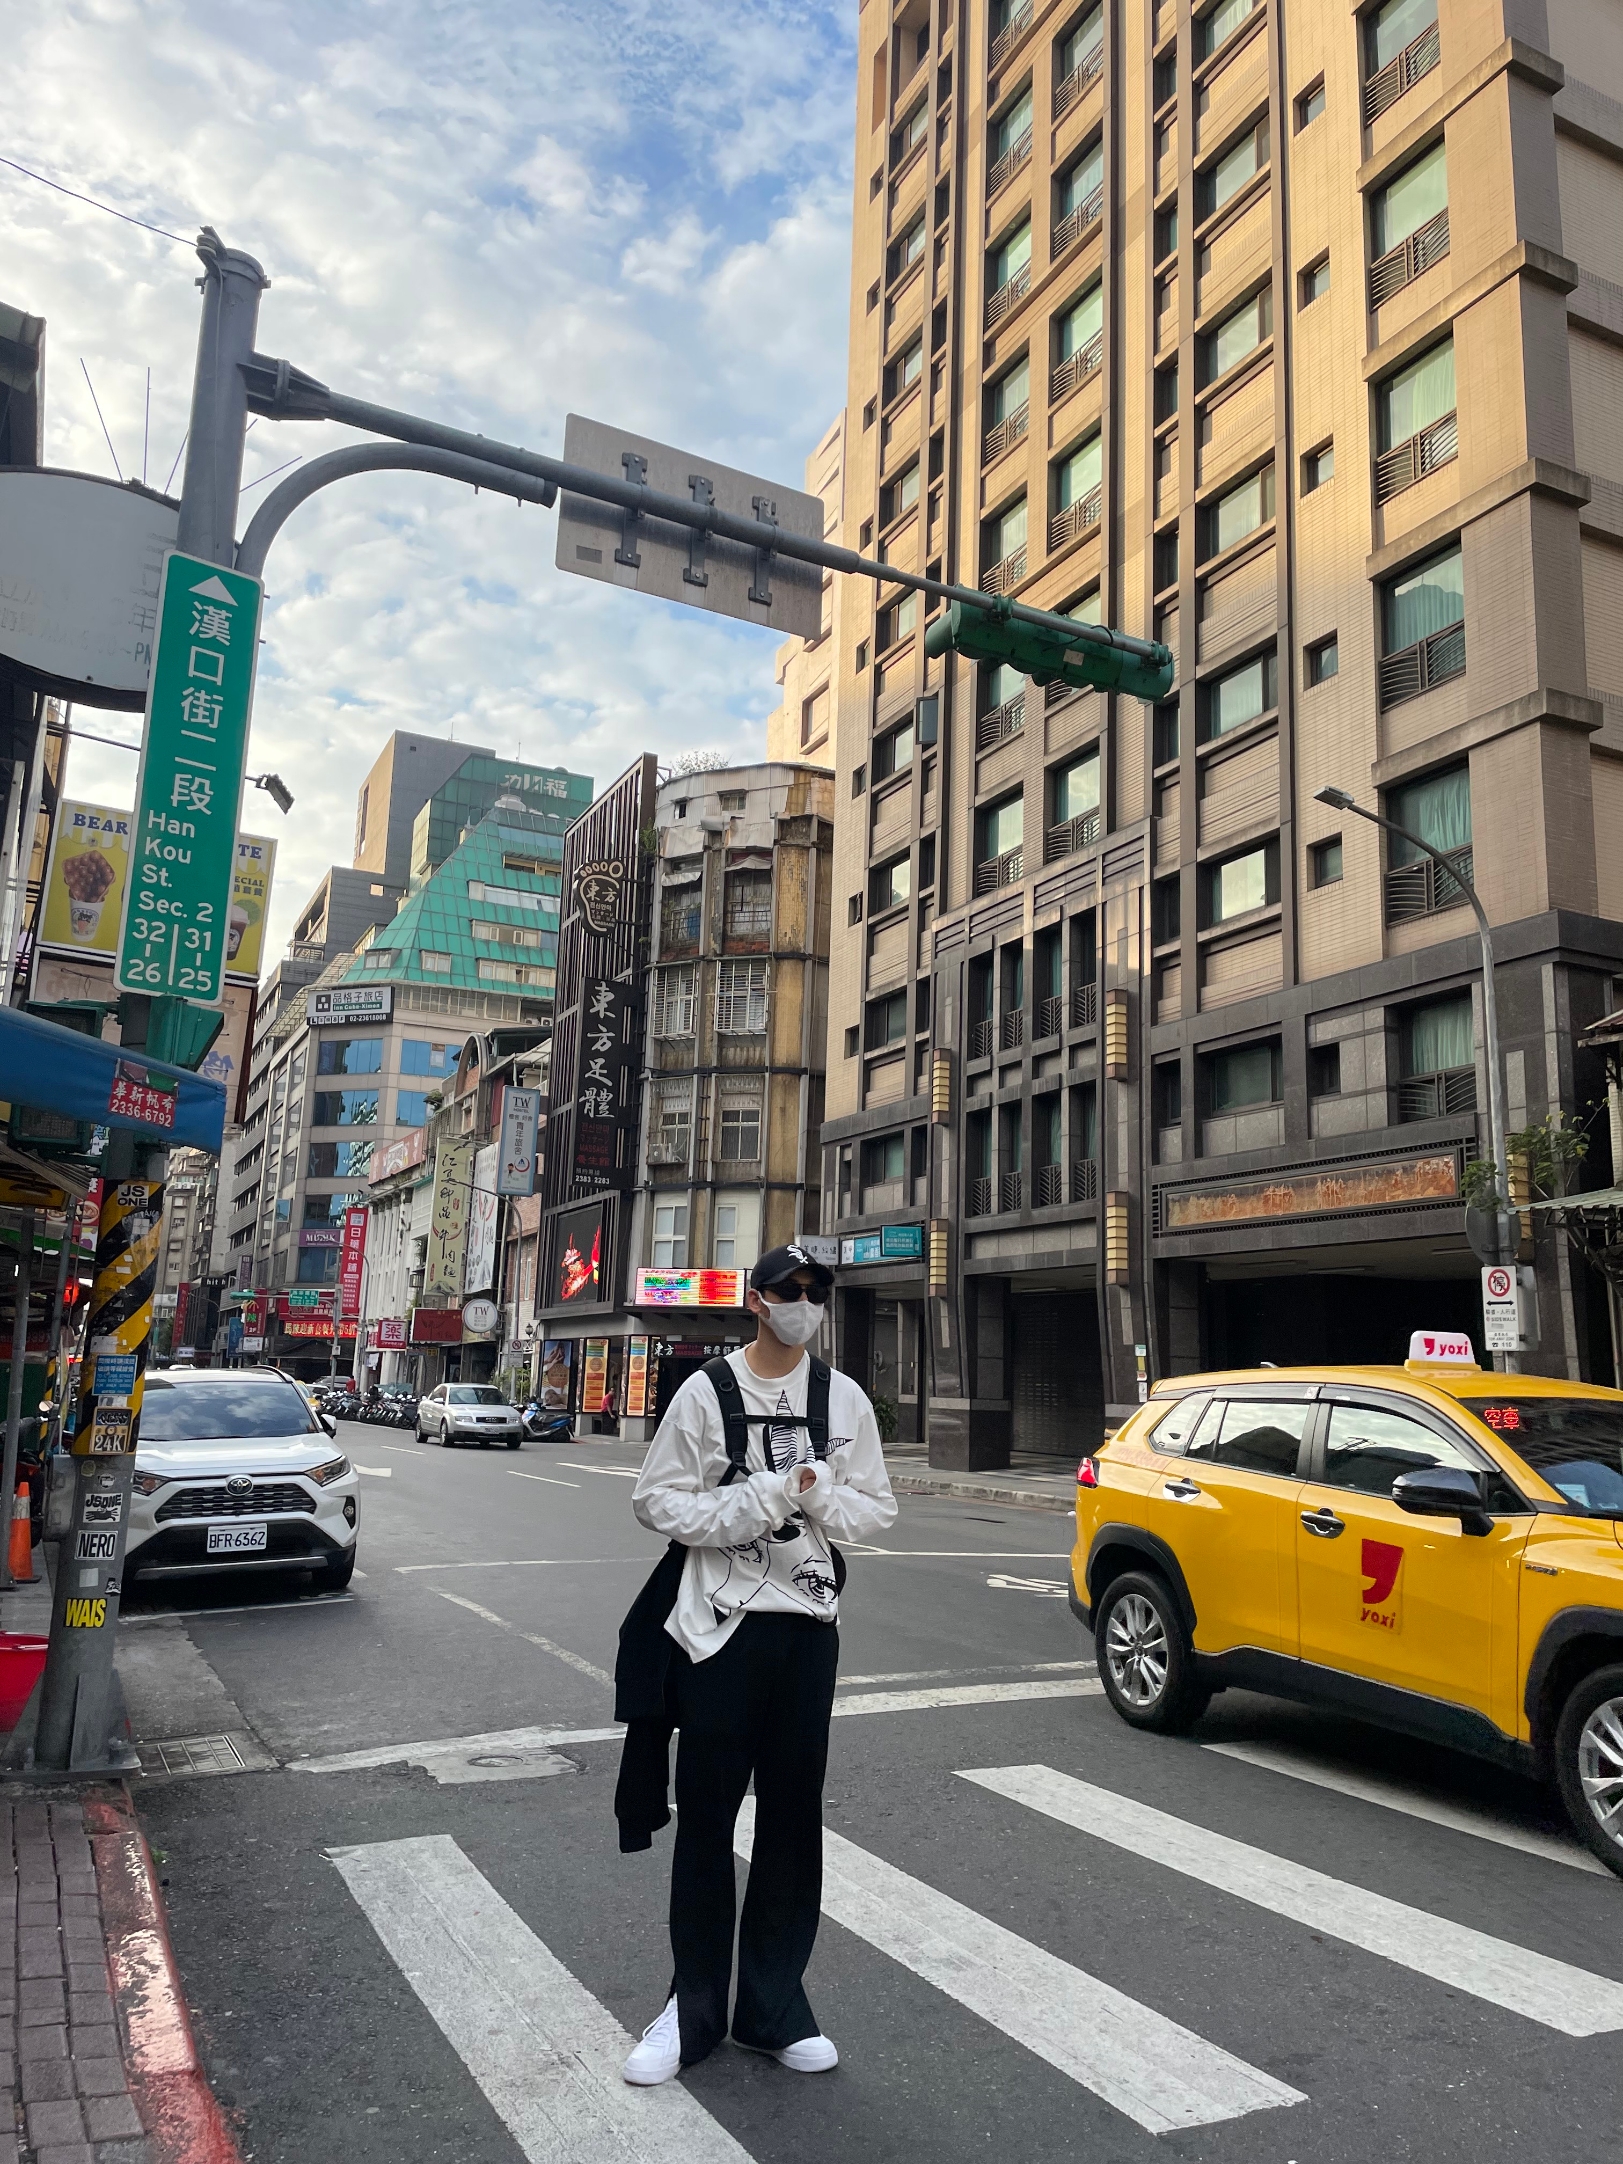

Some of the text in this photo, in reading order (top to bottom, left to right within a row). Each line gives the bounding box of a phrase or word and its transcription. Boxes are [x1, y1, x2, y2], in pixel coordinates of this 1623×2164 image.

[170, 601, 233, 815] 漢口街二段
[73, 813, 128, 835] BEAR
[148, 810, 195, 838] Han
[145, 836, 192, 864] Kou
[141, 864, 172, 887] St.
[586, 880, 617, 902] 東方
[138, 891, 214, 923] Sec. 2
[132, 918, 166, 943] 32
[184, 928, 211, 951] 31
[127, 959, 161, 983] 26
[178, 968, 212, 991] 25
[578, 981, 616, 1118] 東方足體
[113, 1081, 174, 1113] 華新帆布
[513, 1096, 531, 1108] TW
[111, 1099, 172, 1127] 2336-6792
[117, 1198, 148, 1206] ONE
[121, 1185, 145, 1197] JS
[654, 1342, 674, 1356] 東方
[1439, 1341, 1468, 1356] yoxi
[95, 1435, 122, 1452] 24K
[78, 1534, 115, 1557] NERO
[209, 1532, 265, 1548] BFR-6362
[66, 1599, 106, 1627] WAIS
[1361, 1608, 1396, 1629] yoxi
